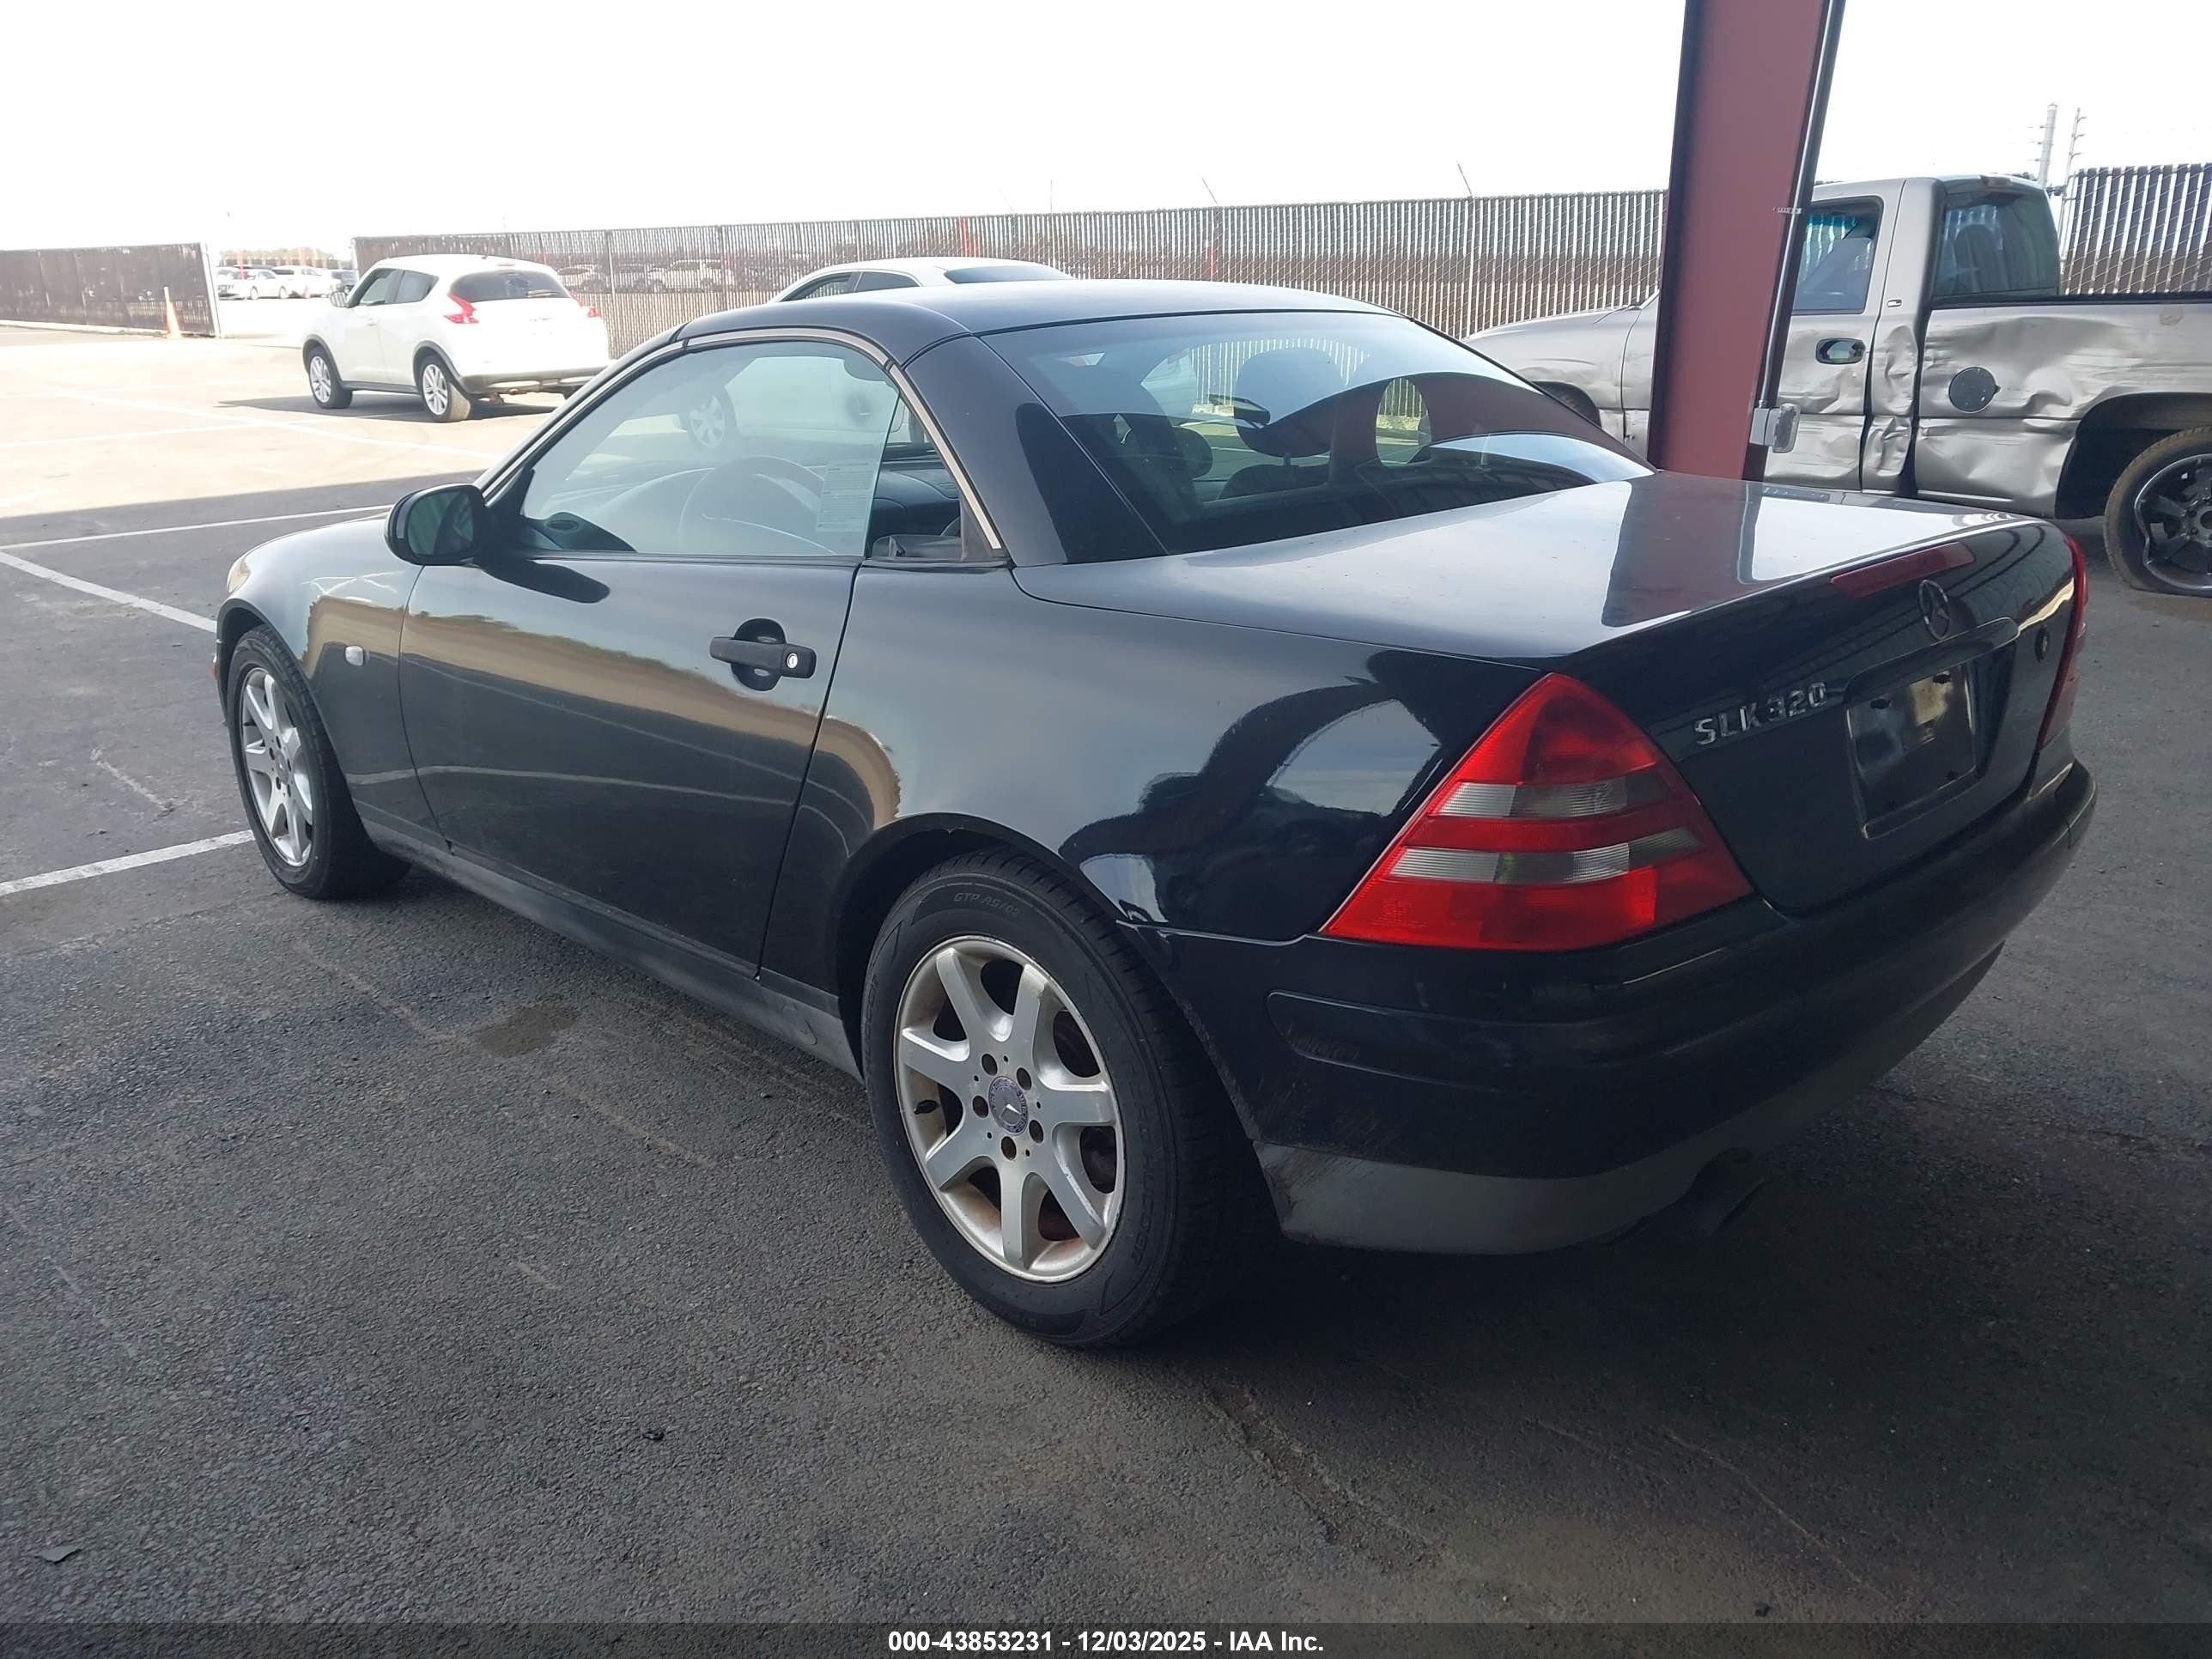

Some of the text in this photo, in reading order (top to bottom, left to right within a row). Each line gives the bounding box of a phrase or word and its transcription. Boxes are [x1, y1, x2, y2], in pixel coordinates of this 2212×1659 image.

[1694, 681, 1826, 745] SLK 320
[953, 891, 981, 902] GTP
